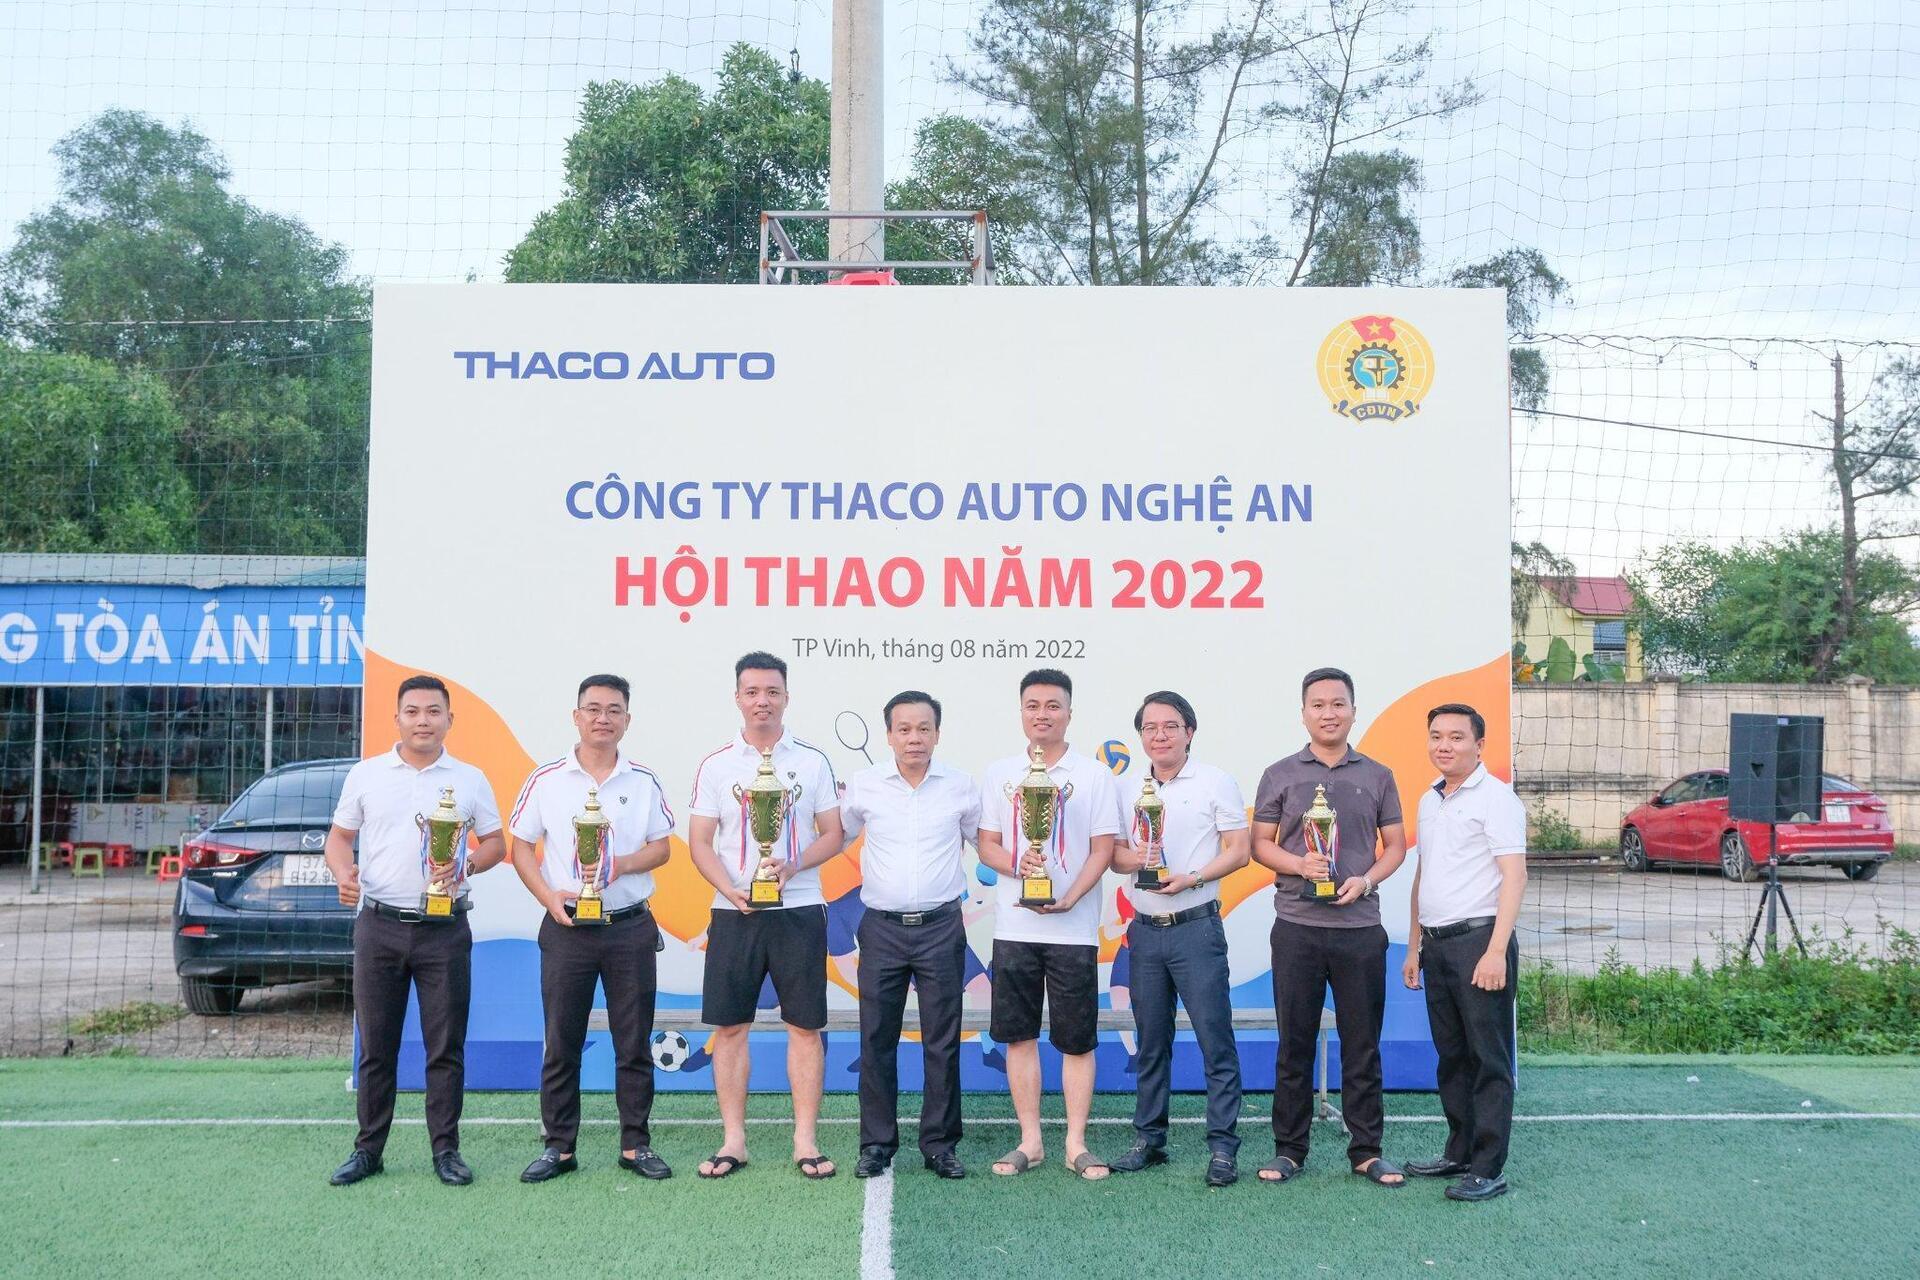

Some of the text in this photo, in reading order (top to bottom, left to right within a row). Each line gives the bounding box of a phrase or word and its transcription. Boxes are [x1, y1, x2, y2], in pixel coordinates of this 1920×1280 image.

[453, 351, 776, 381] THACO AUTO
[565, 473, 1313, 534] CÔNG TY THACO AUTO NGHỆ AN
[615, 544, 1265, 624] HỘI THAO NĂM 2022
[0, 612, 39, 664] G
[55, 598, 172, 665] TÒA
[188, 599, 270, 665] ÁN
[792, 637, 1086, 663] TP Vinh, tháng 08 năm 2022
